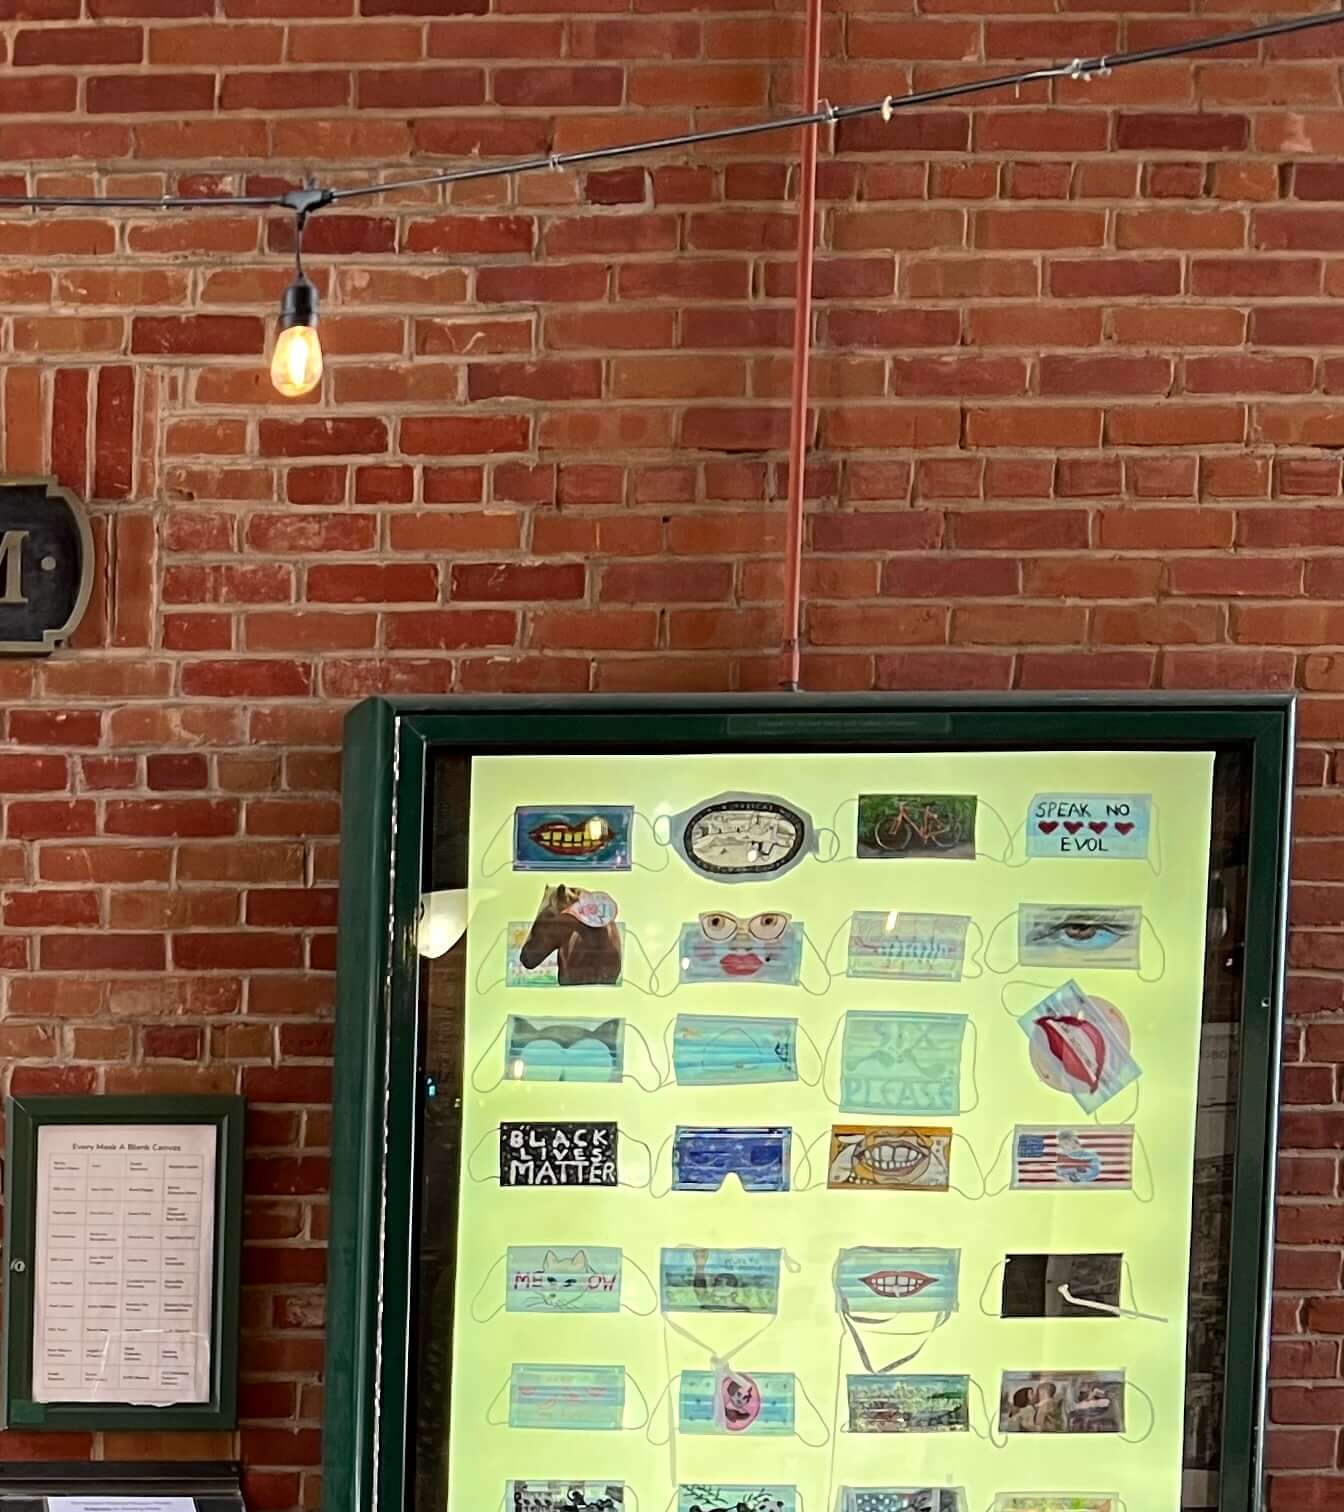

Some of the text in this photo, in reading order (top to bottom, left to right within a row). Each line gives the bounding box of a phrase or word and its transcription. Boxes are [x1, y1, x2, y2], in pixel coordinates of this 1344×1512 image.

[1035, 801, 1130, 818] SPEAK NO
[1060, 836, 1109, 852] EVOL
[510, 1129, 608, 1148] BLACK
[520, 1147, 603, 1161] LIVES
[509, 1160, 615, 1185] MATTER
